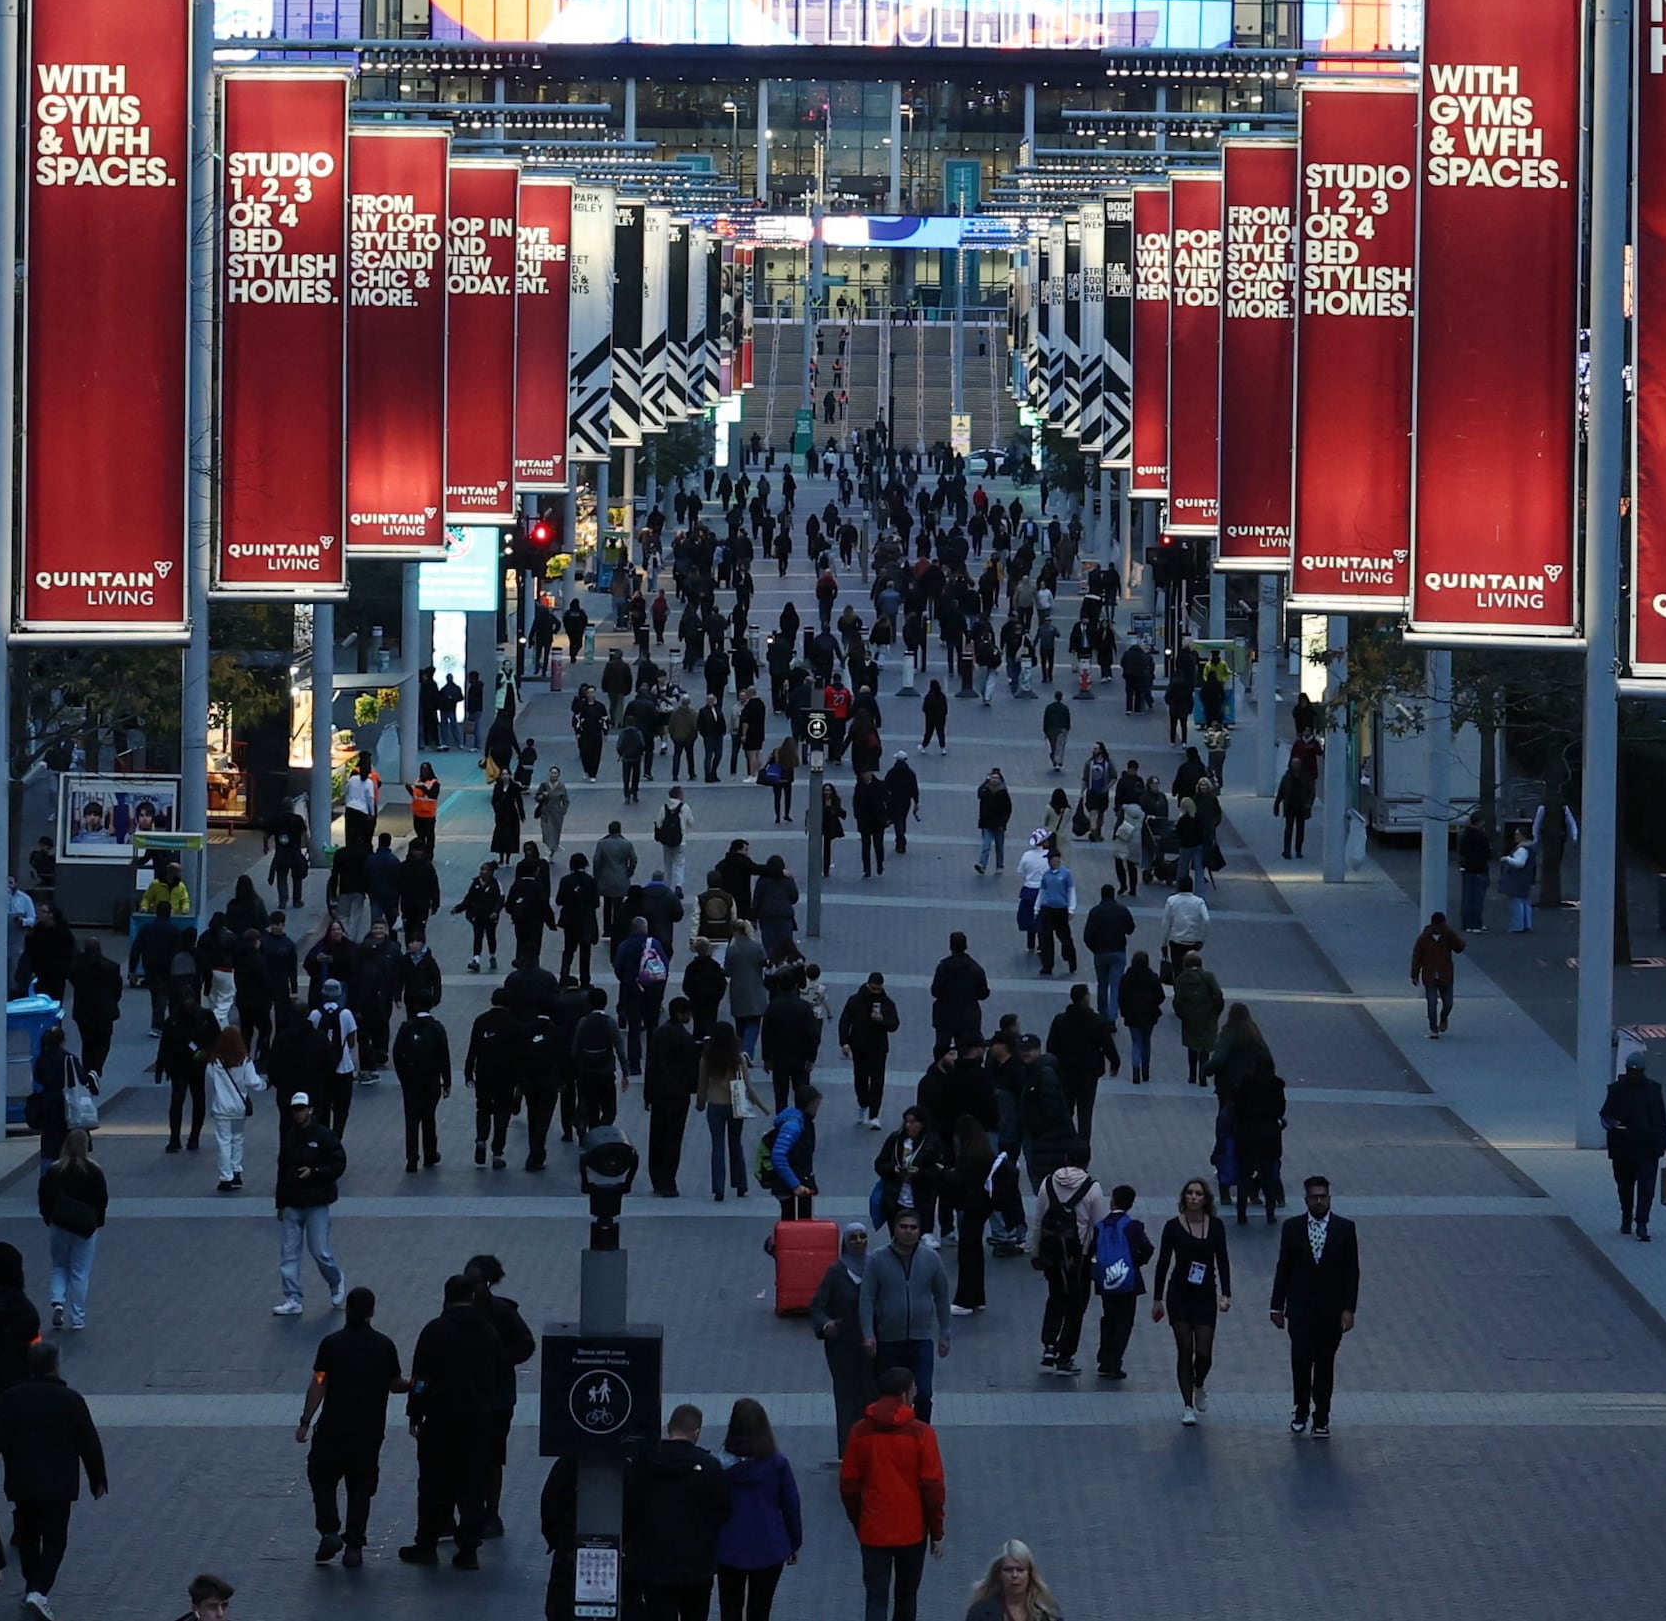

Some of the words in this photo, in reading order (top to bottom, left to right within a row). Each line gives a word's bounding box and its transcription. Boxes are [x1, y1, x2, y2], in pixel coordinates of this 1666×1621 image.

[37, 64, 125, 94] WITH
[1430, 64, 1519, 94] WITH
[36, 94, 140, 125] GYMS
[1430, 95, 1533, 126] GYMS
[36, 125, 62, 155] &
[73, 126, 149, 155] WFH
[1429, 126, 1455, 156] &
[1467, 128, 1543, 157] WFH
[35, 156, 176, 186] SPACES.
[228, 152, 334, 177] STUDIO
[1428, 157, 1568, 189] SPACES.
[1306, 164, 1411, 190] STUDIO
[261, 178, 287, 206] 2,
[294, 178, 312, 202] 3
[574, 193, 601, 203] PARK
[351, 195, 413, 213] FROM
[1307, 191, 1331, 219] 1,
[1338, 191, 1366, 219] 2,
[1370, 191, 1389, 215] 3
[228, 203, 272, 227] OR
[278, 203, 298, 227] 4
[351, 214, 380, 232] NY
[387, 214, 436, 232] LOFT
[1228, 206, 1289, 225] FROM
[448, 217, 485, 236] OP
[490, 218, 512, 237] IN
[517, 227, 549, 244] OVE
[1228, 225, 1258, 243] NY
[1264, 225, 1295, 243] LO
[1305, 216, 1352, 239] OR
[1356, 217, 1375, 239] 4
[228, 228, 283, 253] BED
[350, 232, 408, 250] STYLE
[413, 233, 441, 251] TO
[1136, 234, 1171, 250] LOV
[1175, 229, 1221, 248] POP
[350, 251, 433, 269] SCANDI
[517, 244, 566, 261] HERE
[1227, 244, 1285, 262] STYLE
[1306, 241, 1359, 265] BED
[228, 254, 336, 278] STYLISH
[517, 261, 541, 277] OU
[1227, 262, 1296, 281] SCAN
[351, 270, 408, 288] CHIC
[414, 270, 430, 288] &
[448, 275, 511, 294] ODAY.
[517, 277, 549, 294] ENT.
[1107, 274, 1131, 284] DRIN
[1304, 266, 1412, 291] STYLISH
[228, 279, 339, 303] HOMES.
[351, 289, 418, 307] MORE.
[1136, 284, 1170, 300] REN
[1174, 287, 1221, 306] TOD
[1227, 281, 1285, 299] CHIC
[1227, 300, 1294, 318] MORE.
[1304, 291, 1415, 317] HOMES.
[515, 460, 553, 468] INTAIN
[446, 486, 498, 495] UINTAIN
[461, 496, 498, 505] LIVING
[1175, 499, 1219, 509] QUINT
[350, 513, 425, 527] QUINTAIN
[1203, 509, 1218, 517] LIV
[383, 523, 425, 536] LIVING
[1227, 526, 1289, 537] QUINTAI
[228, 543, 320, 558] QUINTAIN
[1259, 537, 1292, 548] LIVIN
[268, 556, 320, 571] LIVING
[1301, 556, 1393, 571] QUINTAIN
[35, 572, 154, 589] QUINTAIN
[1342, 571, 1393, 584] LIVING
[1425, 573, 1544, 591] QUINTAIN
[87, 590, 155, 606] LIVING
[1477, 593, 1544, 609] LIVING
